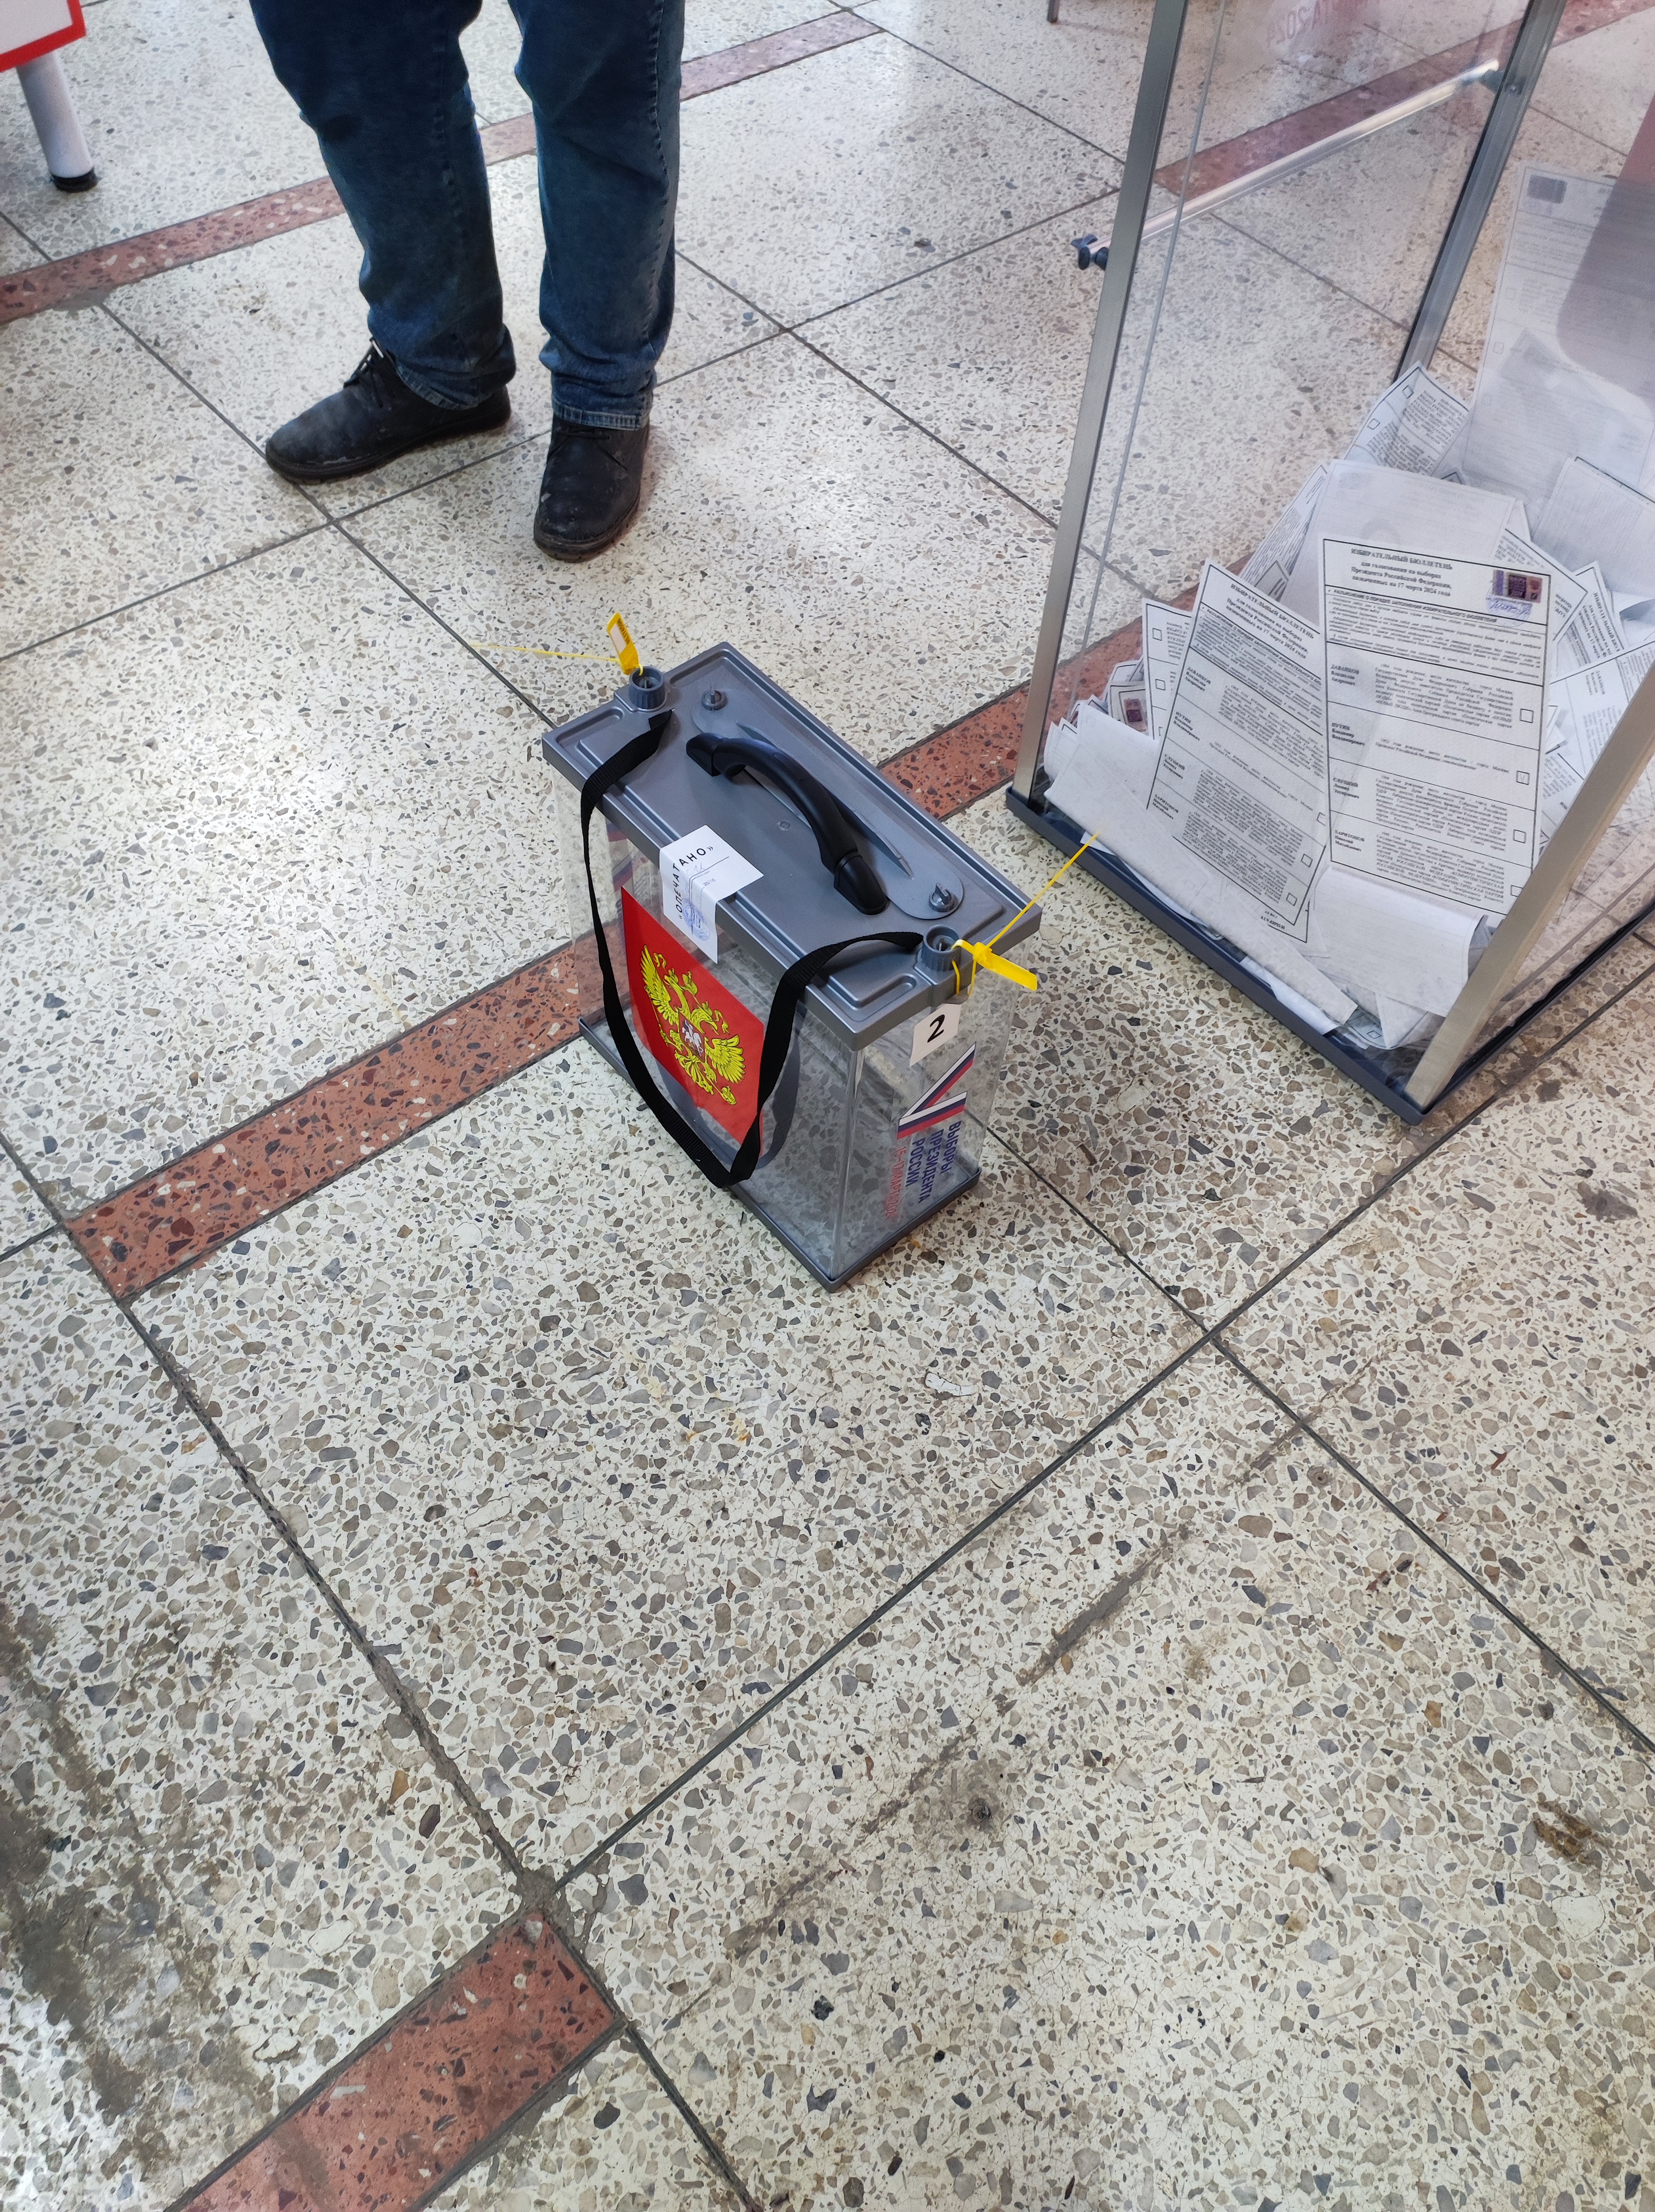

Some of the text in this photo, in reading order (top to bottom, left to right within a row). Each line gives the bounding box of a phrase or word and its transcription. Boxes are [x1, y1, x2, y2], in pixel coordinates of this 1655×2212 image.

[1410, 558, 1452, 570] БЮЛЛЕТЕНЬ
[927, 1014, 946, 1043] 2
[906, 1137, 926, 1187] РОССИИ
[918, 1128, 945, 1204] ПРЕЗИДЕНТА
[940, 1120, 962, 1174] ВЫБОРЫ
